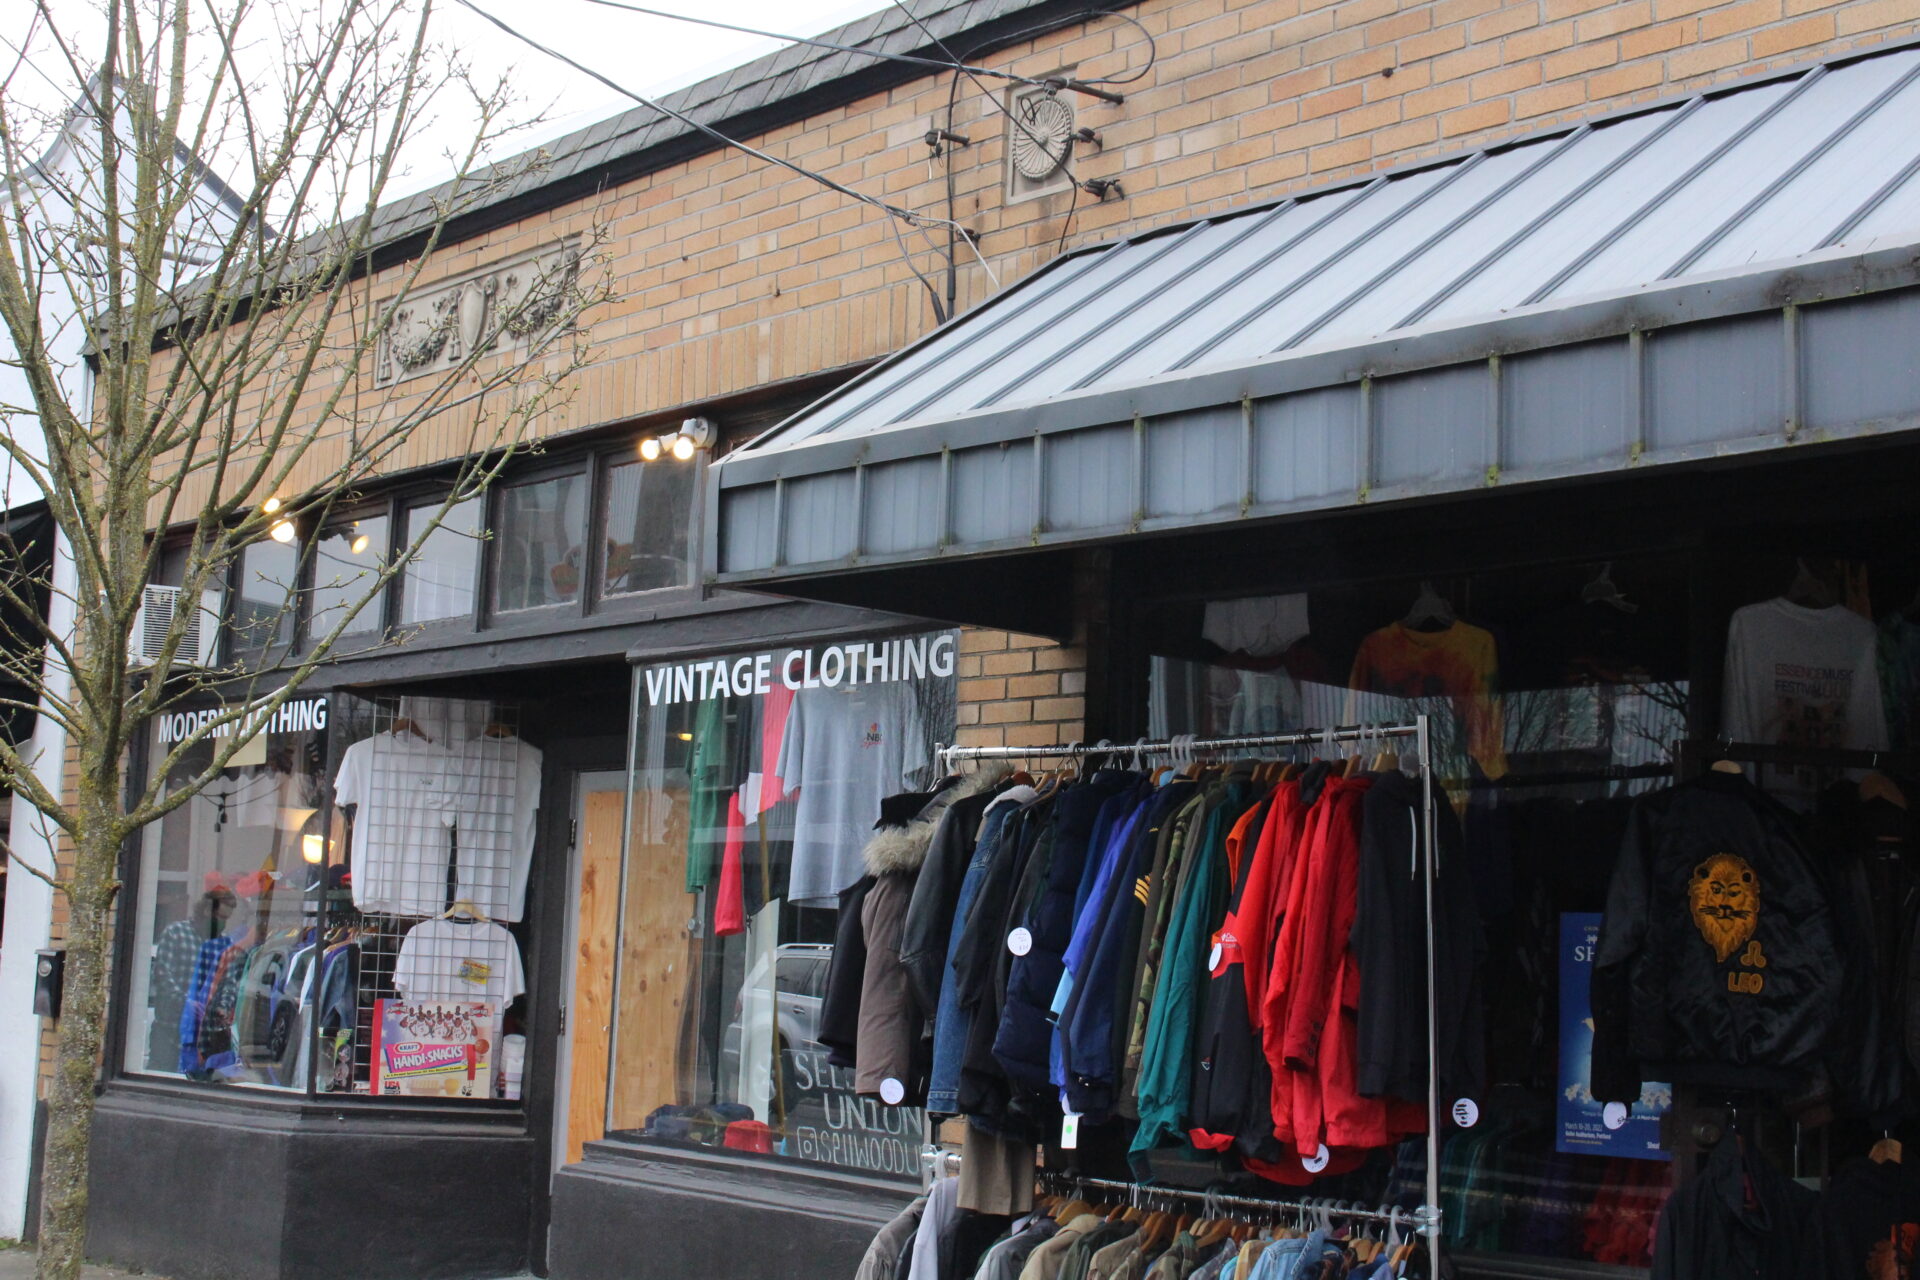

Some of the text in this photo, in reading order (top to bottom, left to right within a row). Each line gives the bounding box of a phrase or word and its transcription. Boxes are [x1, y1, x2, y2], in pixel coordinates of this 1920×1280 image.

[646, 635, 954, 706] VINTAGE CLOTHING
[158, 707, 231, 743] MODERN
[1728, 971, 1763, 995] LEO
[824, 1093, 923, 1136] UNION
